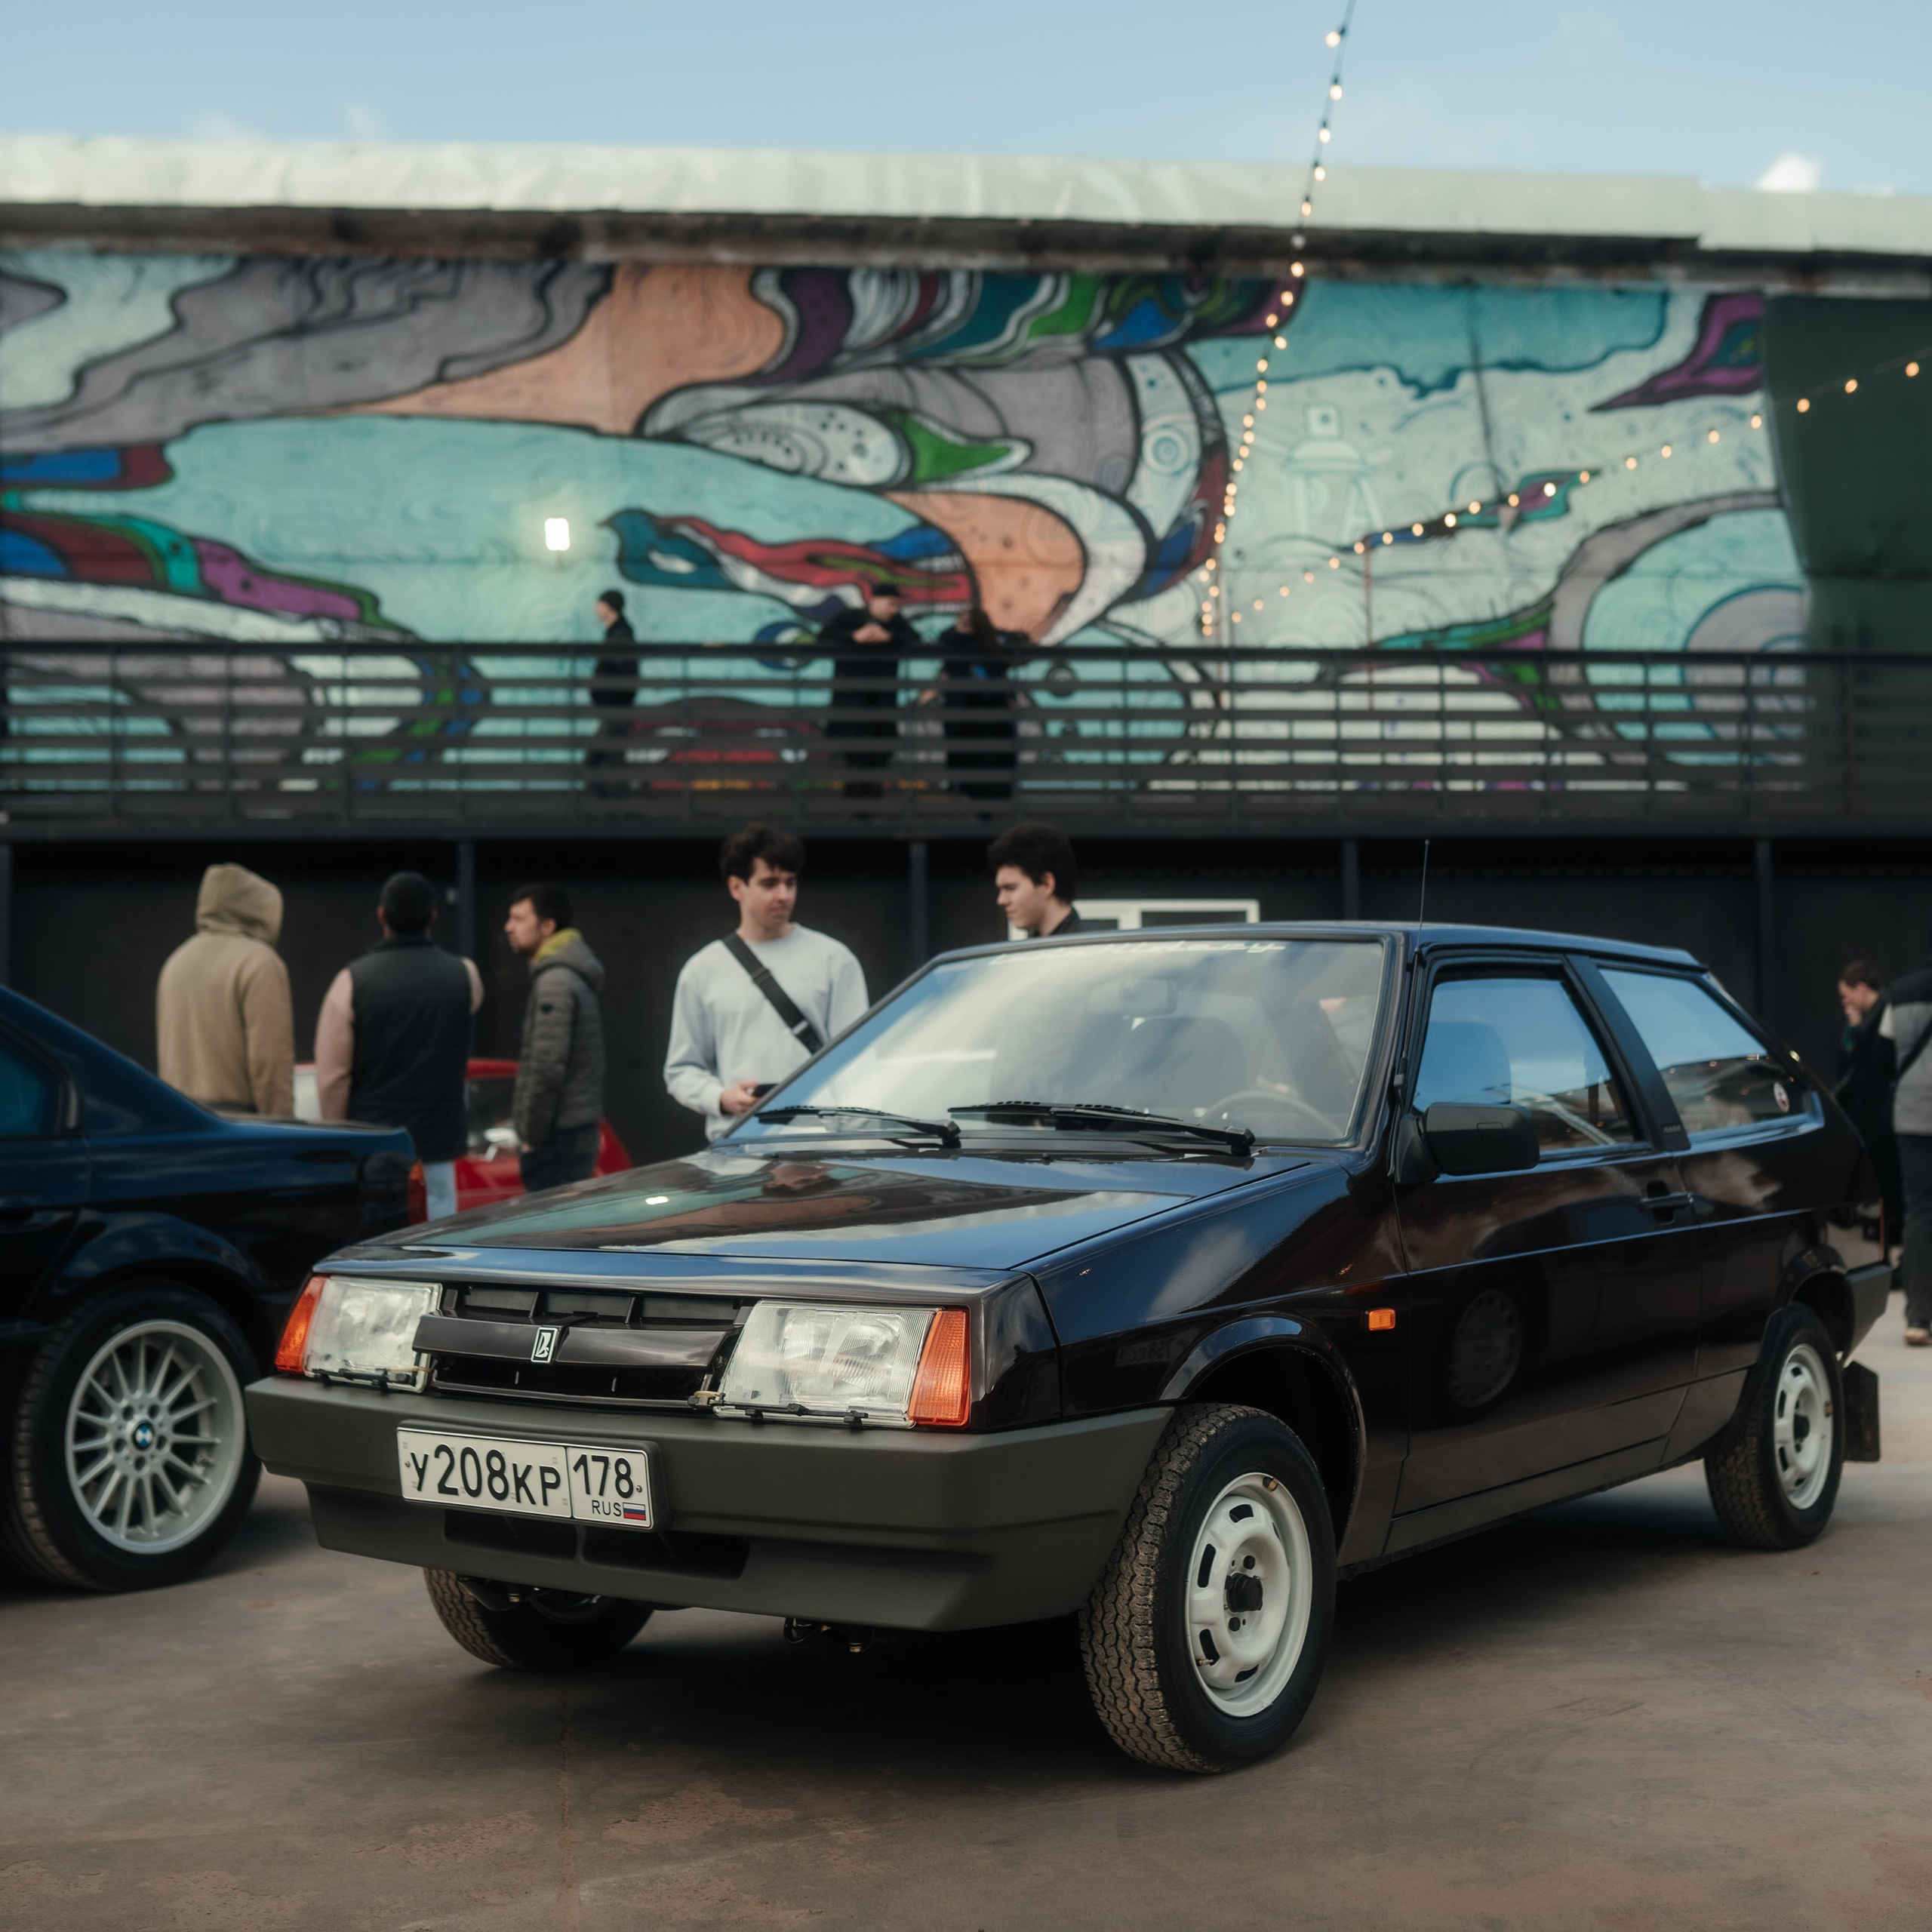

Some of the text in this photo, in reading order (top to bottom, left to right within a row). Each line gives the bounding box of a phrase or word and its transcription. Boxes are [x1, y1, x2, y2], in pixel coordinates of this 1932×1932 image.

[411, 1444, 634, 1506] У208КР 178
[592, 1500, 622, 1517] RUS
